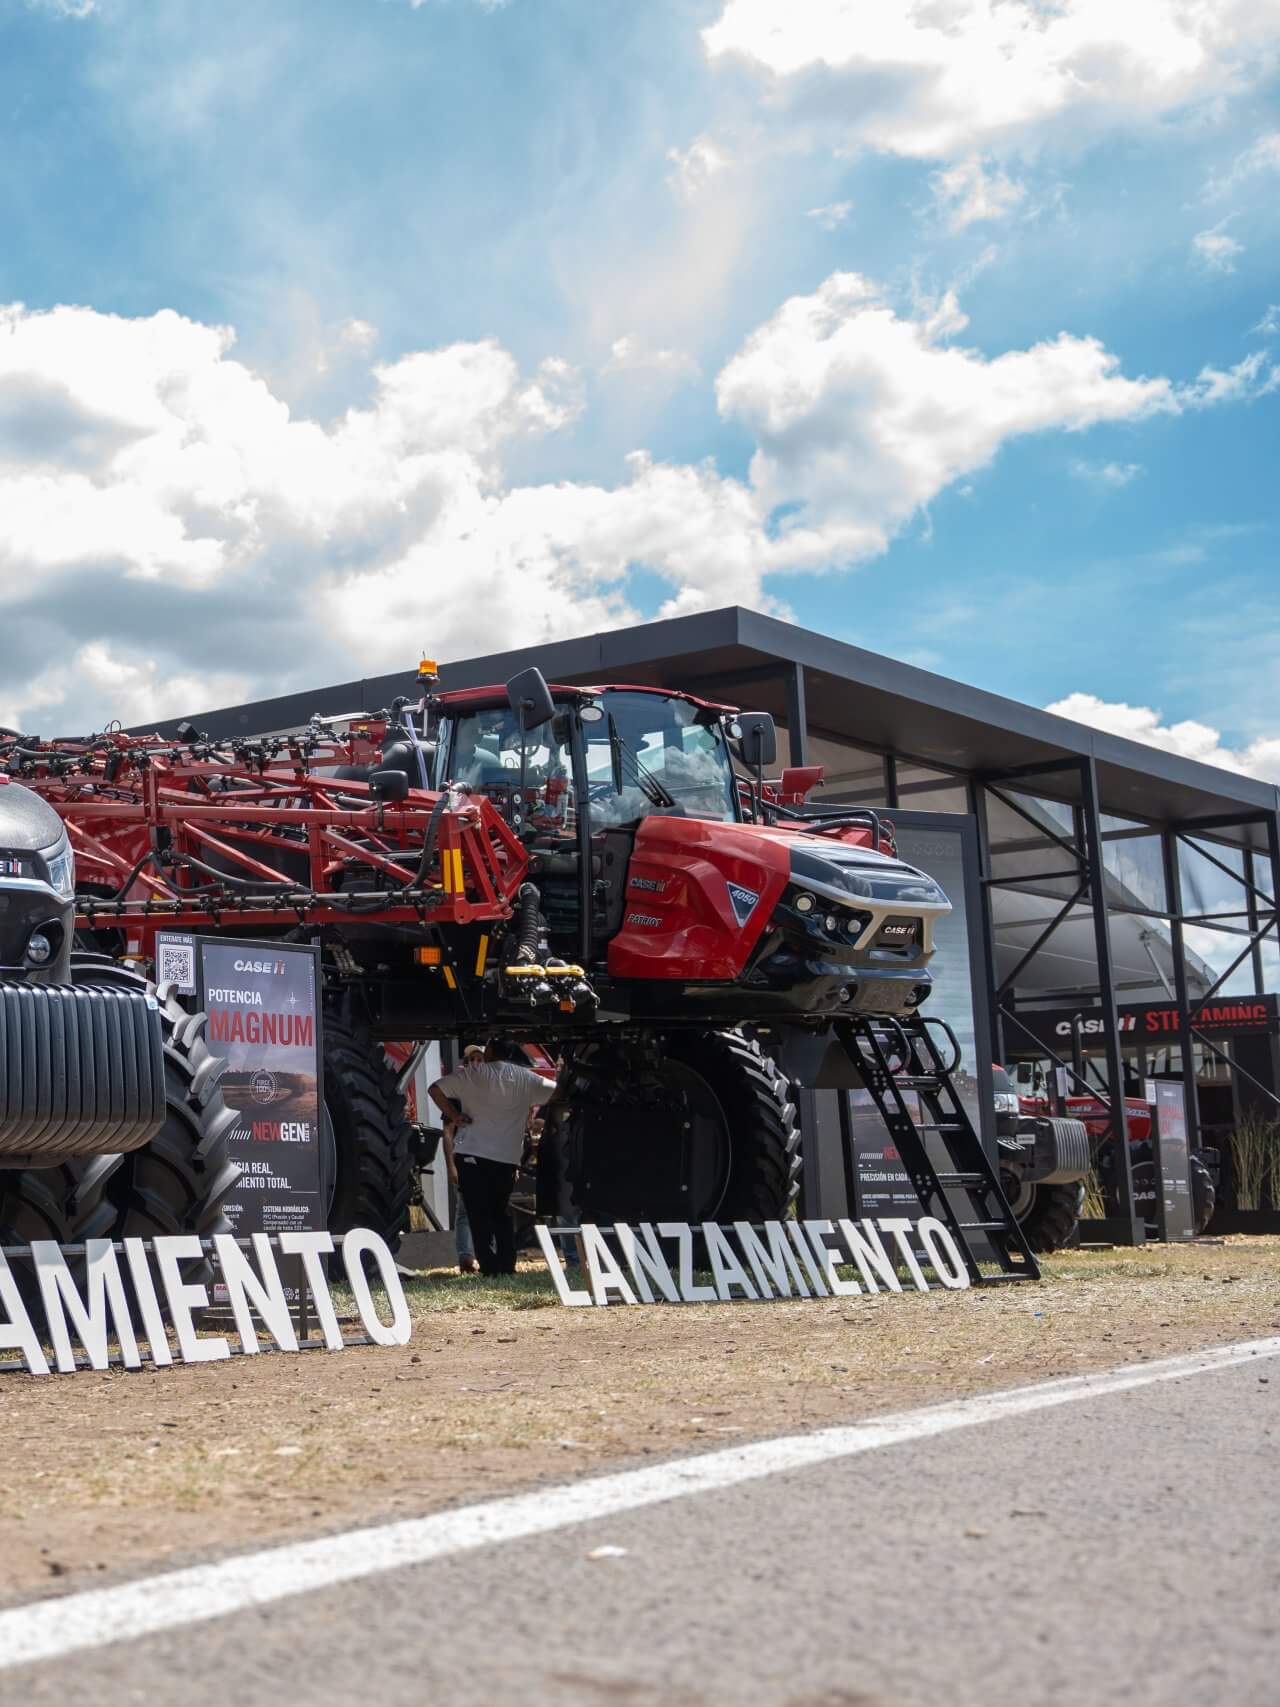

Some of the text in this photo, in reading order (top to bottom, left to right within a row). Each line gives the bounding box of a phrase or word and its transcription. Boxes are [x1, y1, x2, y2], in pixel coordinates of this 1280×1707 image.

[630, 877, 656, 890] CASE
[626, 913, 663, 928] PATRIOT
[884, 926, 907, 934] CASE
[234, 959, 272, 974] CASE
[208, 988, 262, 1005] POTENCIA
[209, 1007, 313, 1047] MAGNUM
[252, 1162, 274, 1176] REAL,
[236, 1176, 265, 1189] MIENTO
[535, 1216, 971, 1306] LANZAMIENTO
